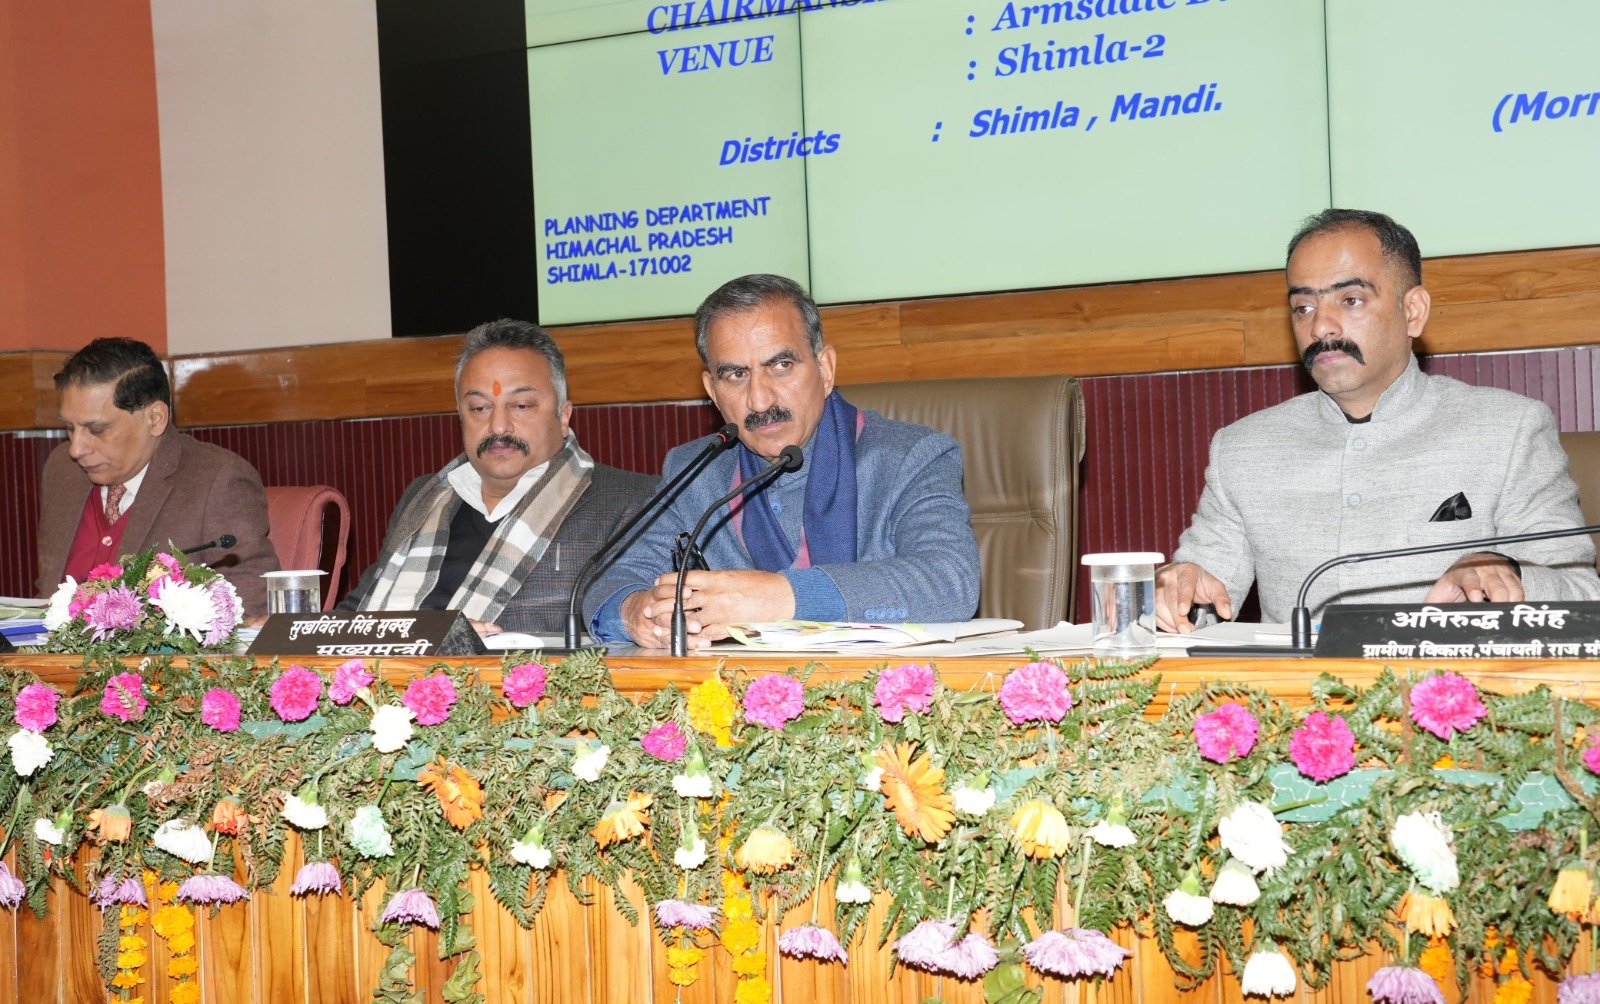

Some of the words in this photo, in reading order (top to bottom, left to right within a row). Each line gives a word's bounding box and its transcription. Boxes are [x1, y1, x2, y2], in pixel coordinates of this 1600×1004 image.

[657, 35, 775, 75] VENUE
[995, 33, 1166, 77] Shimla-2
[719, 130, 841, 166] Districts
[969, 101, 1081, 138] Shimla
[1110, 83, 1223, 123] Mandi.
[544, 210, 639, 237] PLANNING
[646, 196, 771, 227] DEPARTMENT
[546, 235, 642, 260] HIMACHAL
[648, 226, 733, 251] PRADESH
[546, 255, 692, 285] SHIMLA-171002
[288, 615, 349, 641] सुखविंदर
[347, 614, 379, 636] सिंह
[376, 618, 417, 639] सुक्खू
[1391, 606, 1504, 630] अनिरुद्ध
[1510, 604, 1570, 630] सिंह
[1362, 640, 1416, 657] ग्रामीण
[1547, 643, 1581, 656] राज
[1583, 639, 1600, 656] मं
